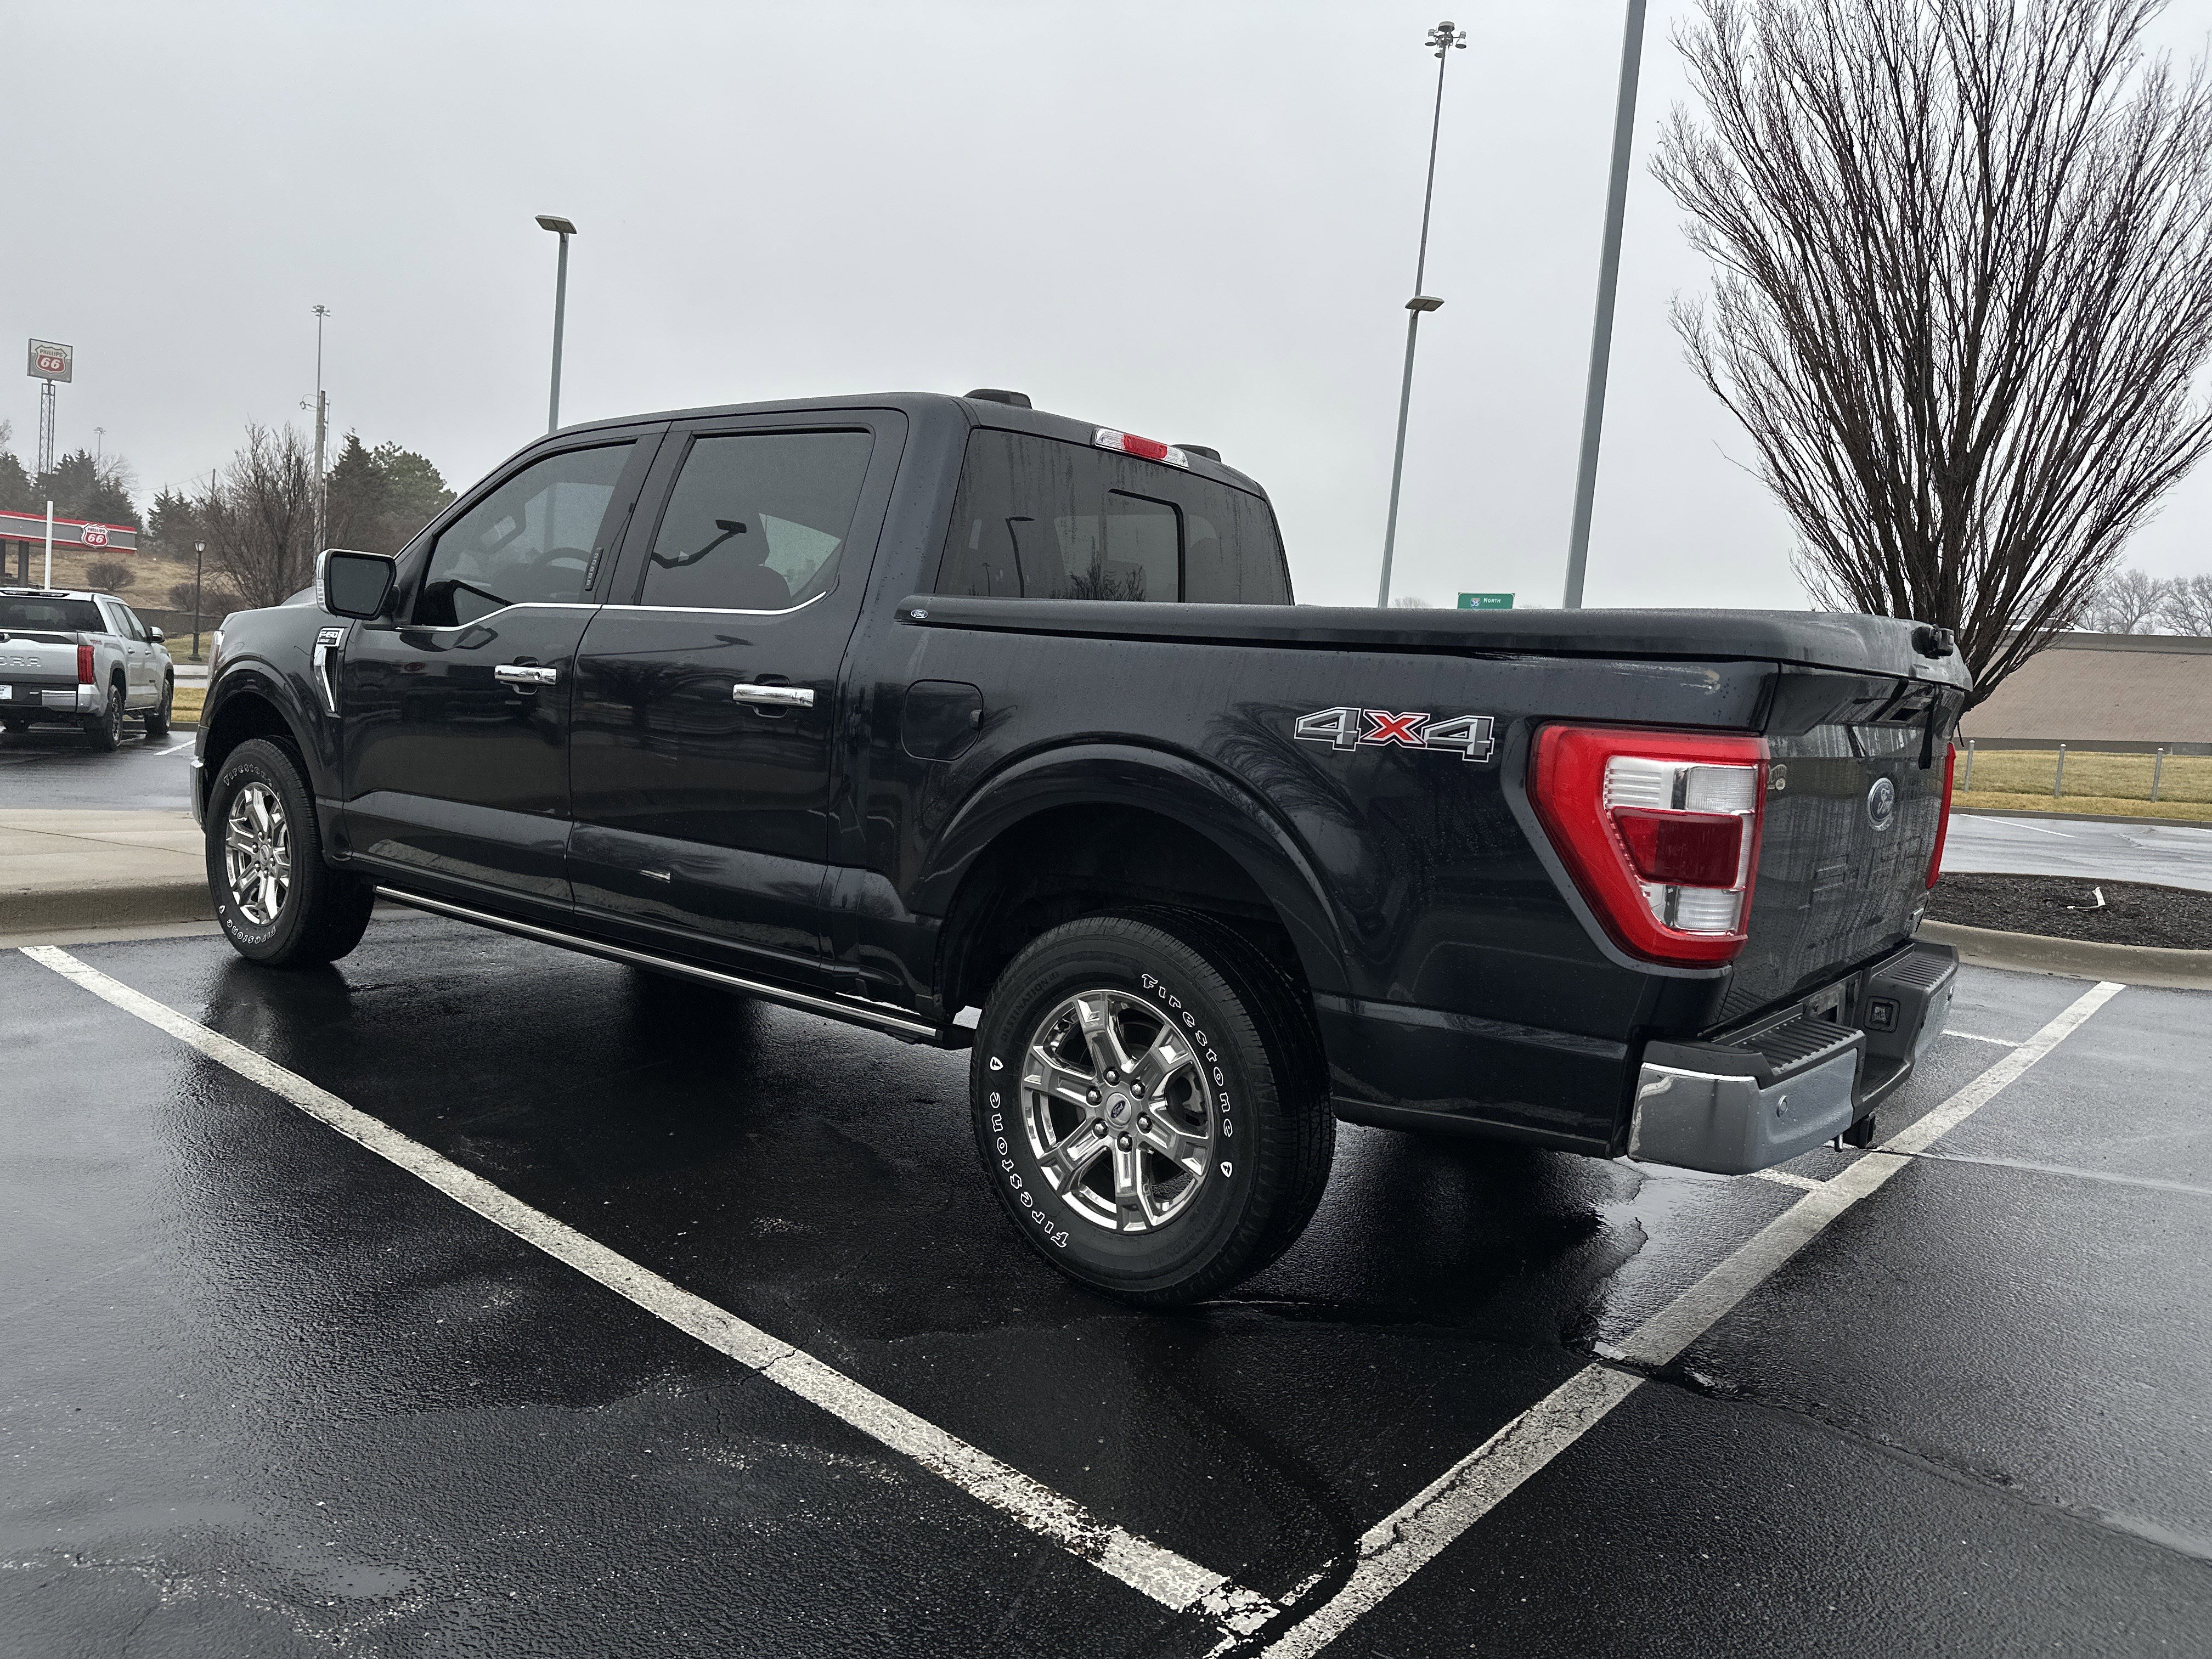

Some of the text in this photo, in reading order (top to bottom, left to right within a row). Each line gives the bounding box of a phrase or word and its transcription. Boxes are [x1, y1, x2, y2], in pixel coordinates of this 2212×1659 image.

[40, 349, 63, 357] PHILLIPS
[41, 357, 61, 369] 66
[88, 534, 105, 544] 66
[227, 919, 276, 944] Firestone
[1142, 973, 1233, 1138] Firestone
[990, 1091, 1069, 1248] Firestone
